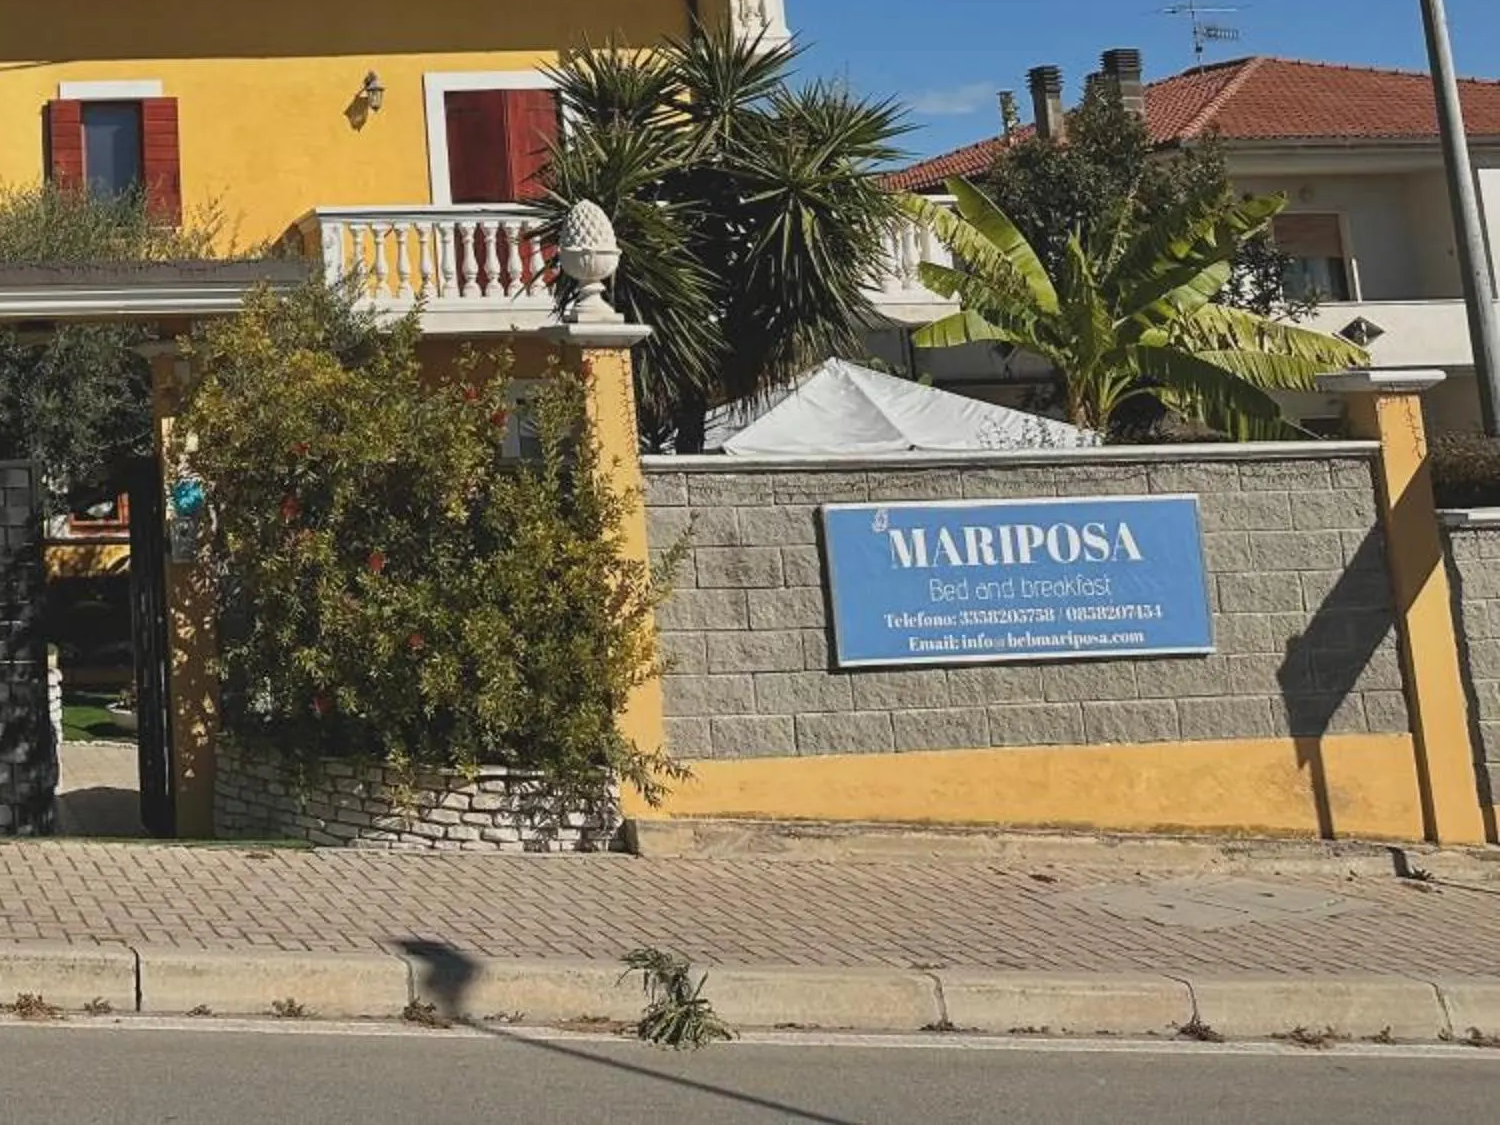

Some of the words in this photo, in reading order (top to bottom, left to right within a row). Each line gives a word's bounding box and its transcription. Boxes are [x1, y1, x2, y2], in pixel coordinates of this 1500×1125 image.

[889, 522, 1143, 568] MARIPOSA
[929, 577, 969, 602] Bed
[975, 575, 1015, 600] and
[1020, 572, 1112, 598] breakfast
[884, 611, 957, 628] Telefono:
[907, 635, 960, 652] Email:
